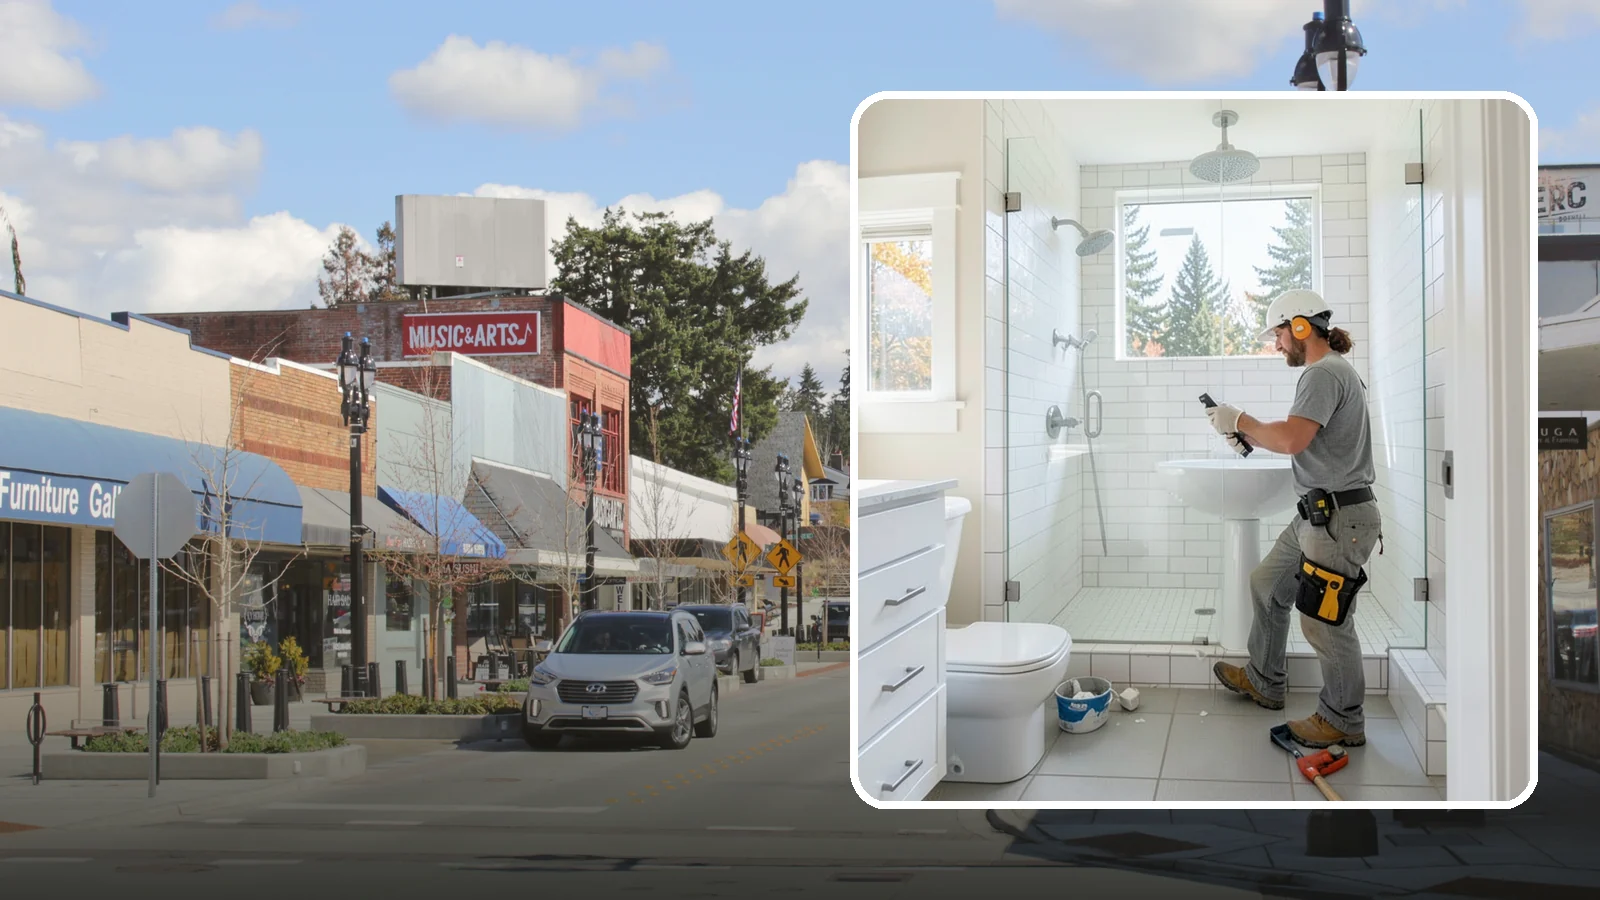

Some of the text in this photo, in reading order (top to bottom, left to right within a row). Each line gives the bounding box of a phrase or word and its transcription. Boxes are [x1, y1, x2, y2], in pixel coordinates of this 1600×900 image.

[409, 322, 520, 349] MUSIC&ARTS
[0, 471, 122, 519] Furniture Gal
[453, 563, 480, 574] SUSHI
